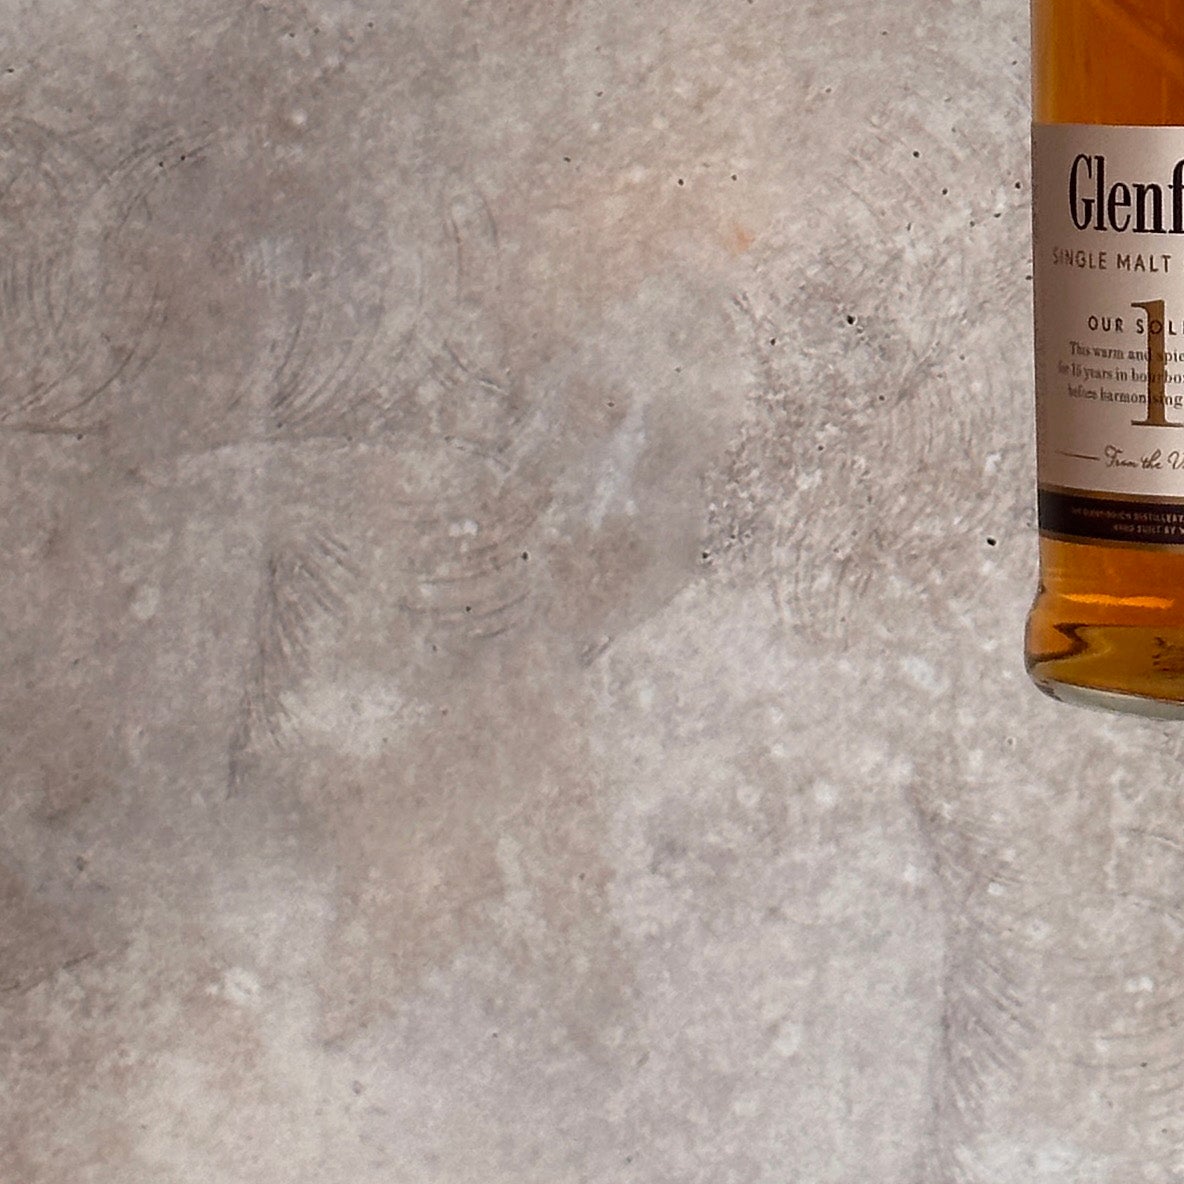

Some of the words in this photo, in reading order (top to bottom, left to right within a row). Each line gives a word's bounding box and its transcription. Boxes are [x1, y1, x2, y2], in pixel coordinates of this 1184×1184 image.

[1053, 247, 1107, 270] SINGLE
[1116, 253, 1171, 273] MALT
[1088, 315, 1123, 333] OUR
[1070, 341, 1089, 356] This
[1092, 346, 1124, 360] warm
[1128, 347, 1152, 361] and
[1083, 366, 1112, 381] years
[1115, 366, 1127, 381] in
[1140, 448, 1161, 470] the
